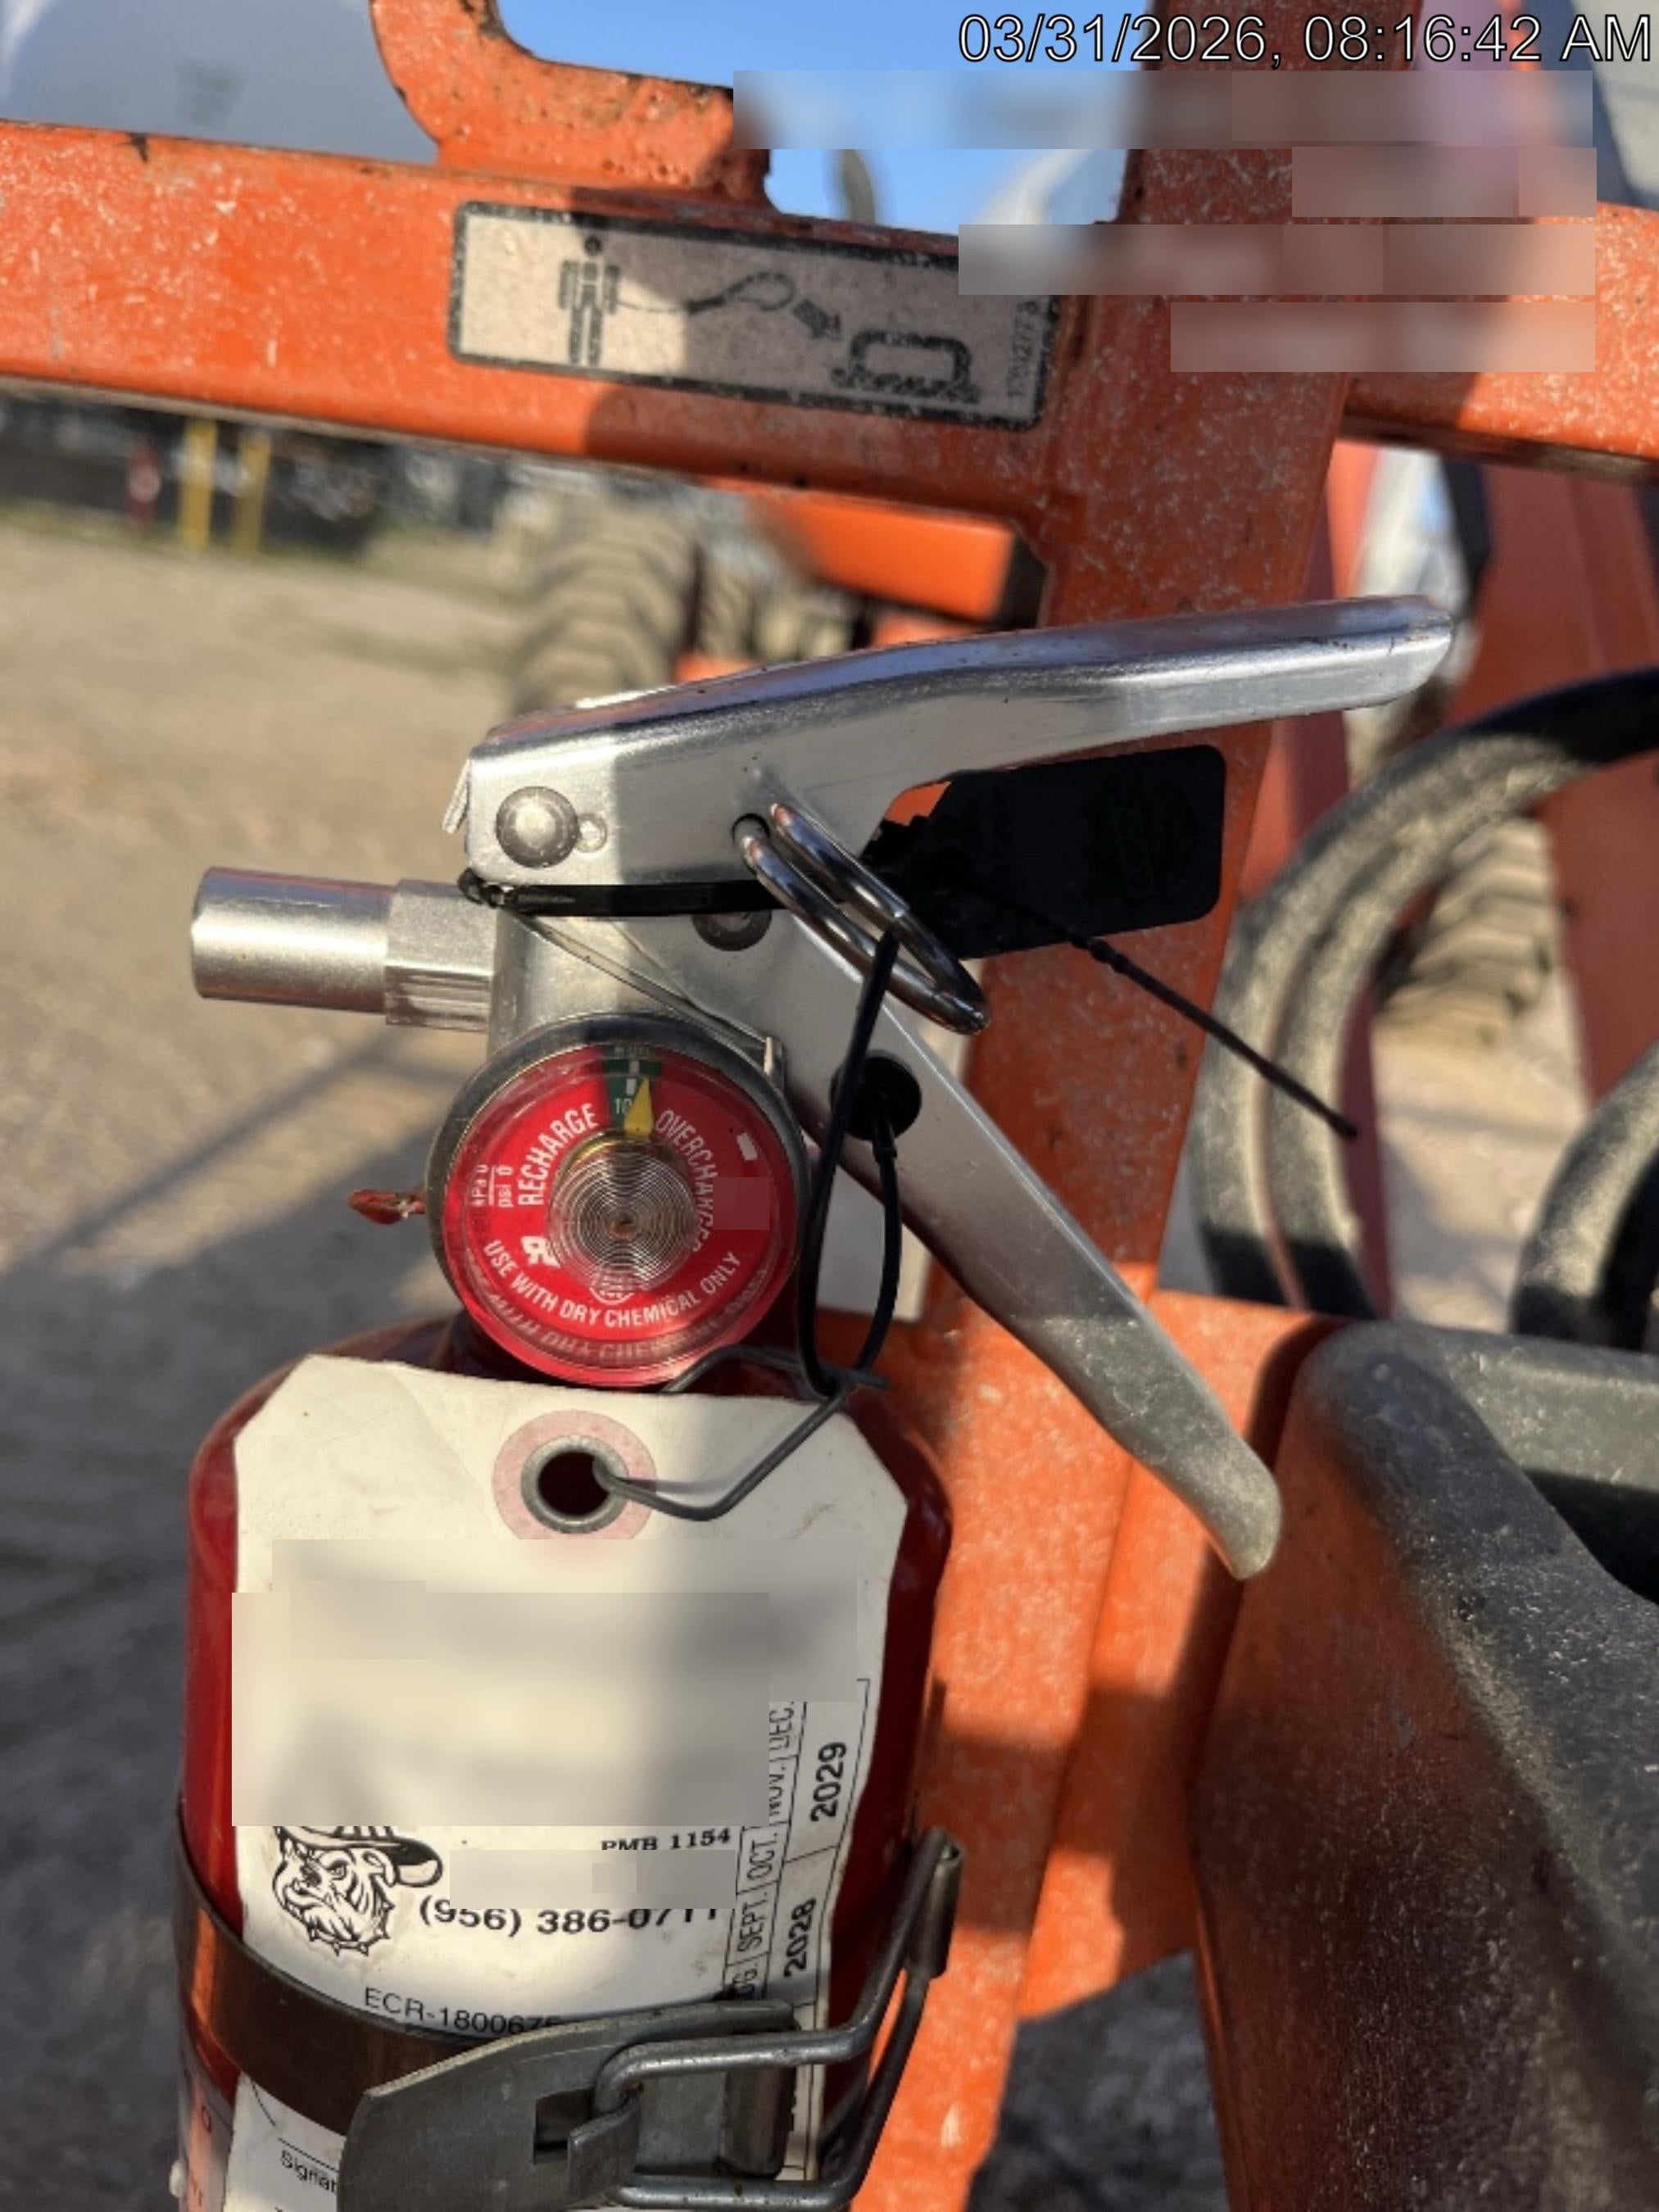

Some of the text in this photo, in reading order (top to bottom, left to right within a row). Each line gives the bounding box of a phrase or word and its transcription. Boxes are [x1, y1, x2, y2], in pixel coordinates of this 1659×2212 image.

[613, 1097, 632, 1115] 10
[518, 1103, 600, 1206] RECHARGE
[483, 1240, 510, 1279] USE
[510, 1271, 557, 1313] WITH
[560, 1299, 600, 1326] DRY
[604, 1289, 703, 1328] CHEMICAL
[700, 1251, 742, 1296] ONLY
[769, 1702, 795, 1752] DEC.
[670, 1828, 732, 1849] 1154
[747, 1832, 777, 1881] OCT.
[784, 1741, 846, 1978] 2028 2029
[419, 1894, 521, 1937] (956)
[738, 1892, 768, 1952] SEPT.
